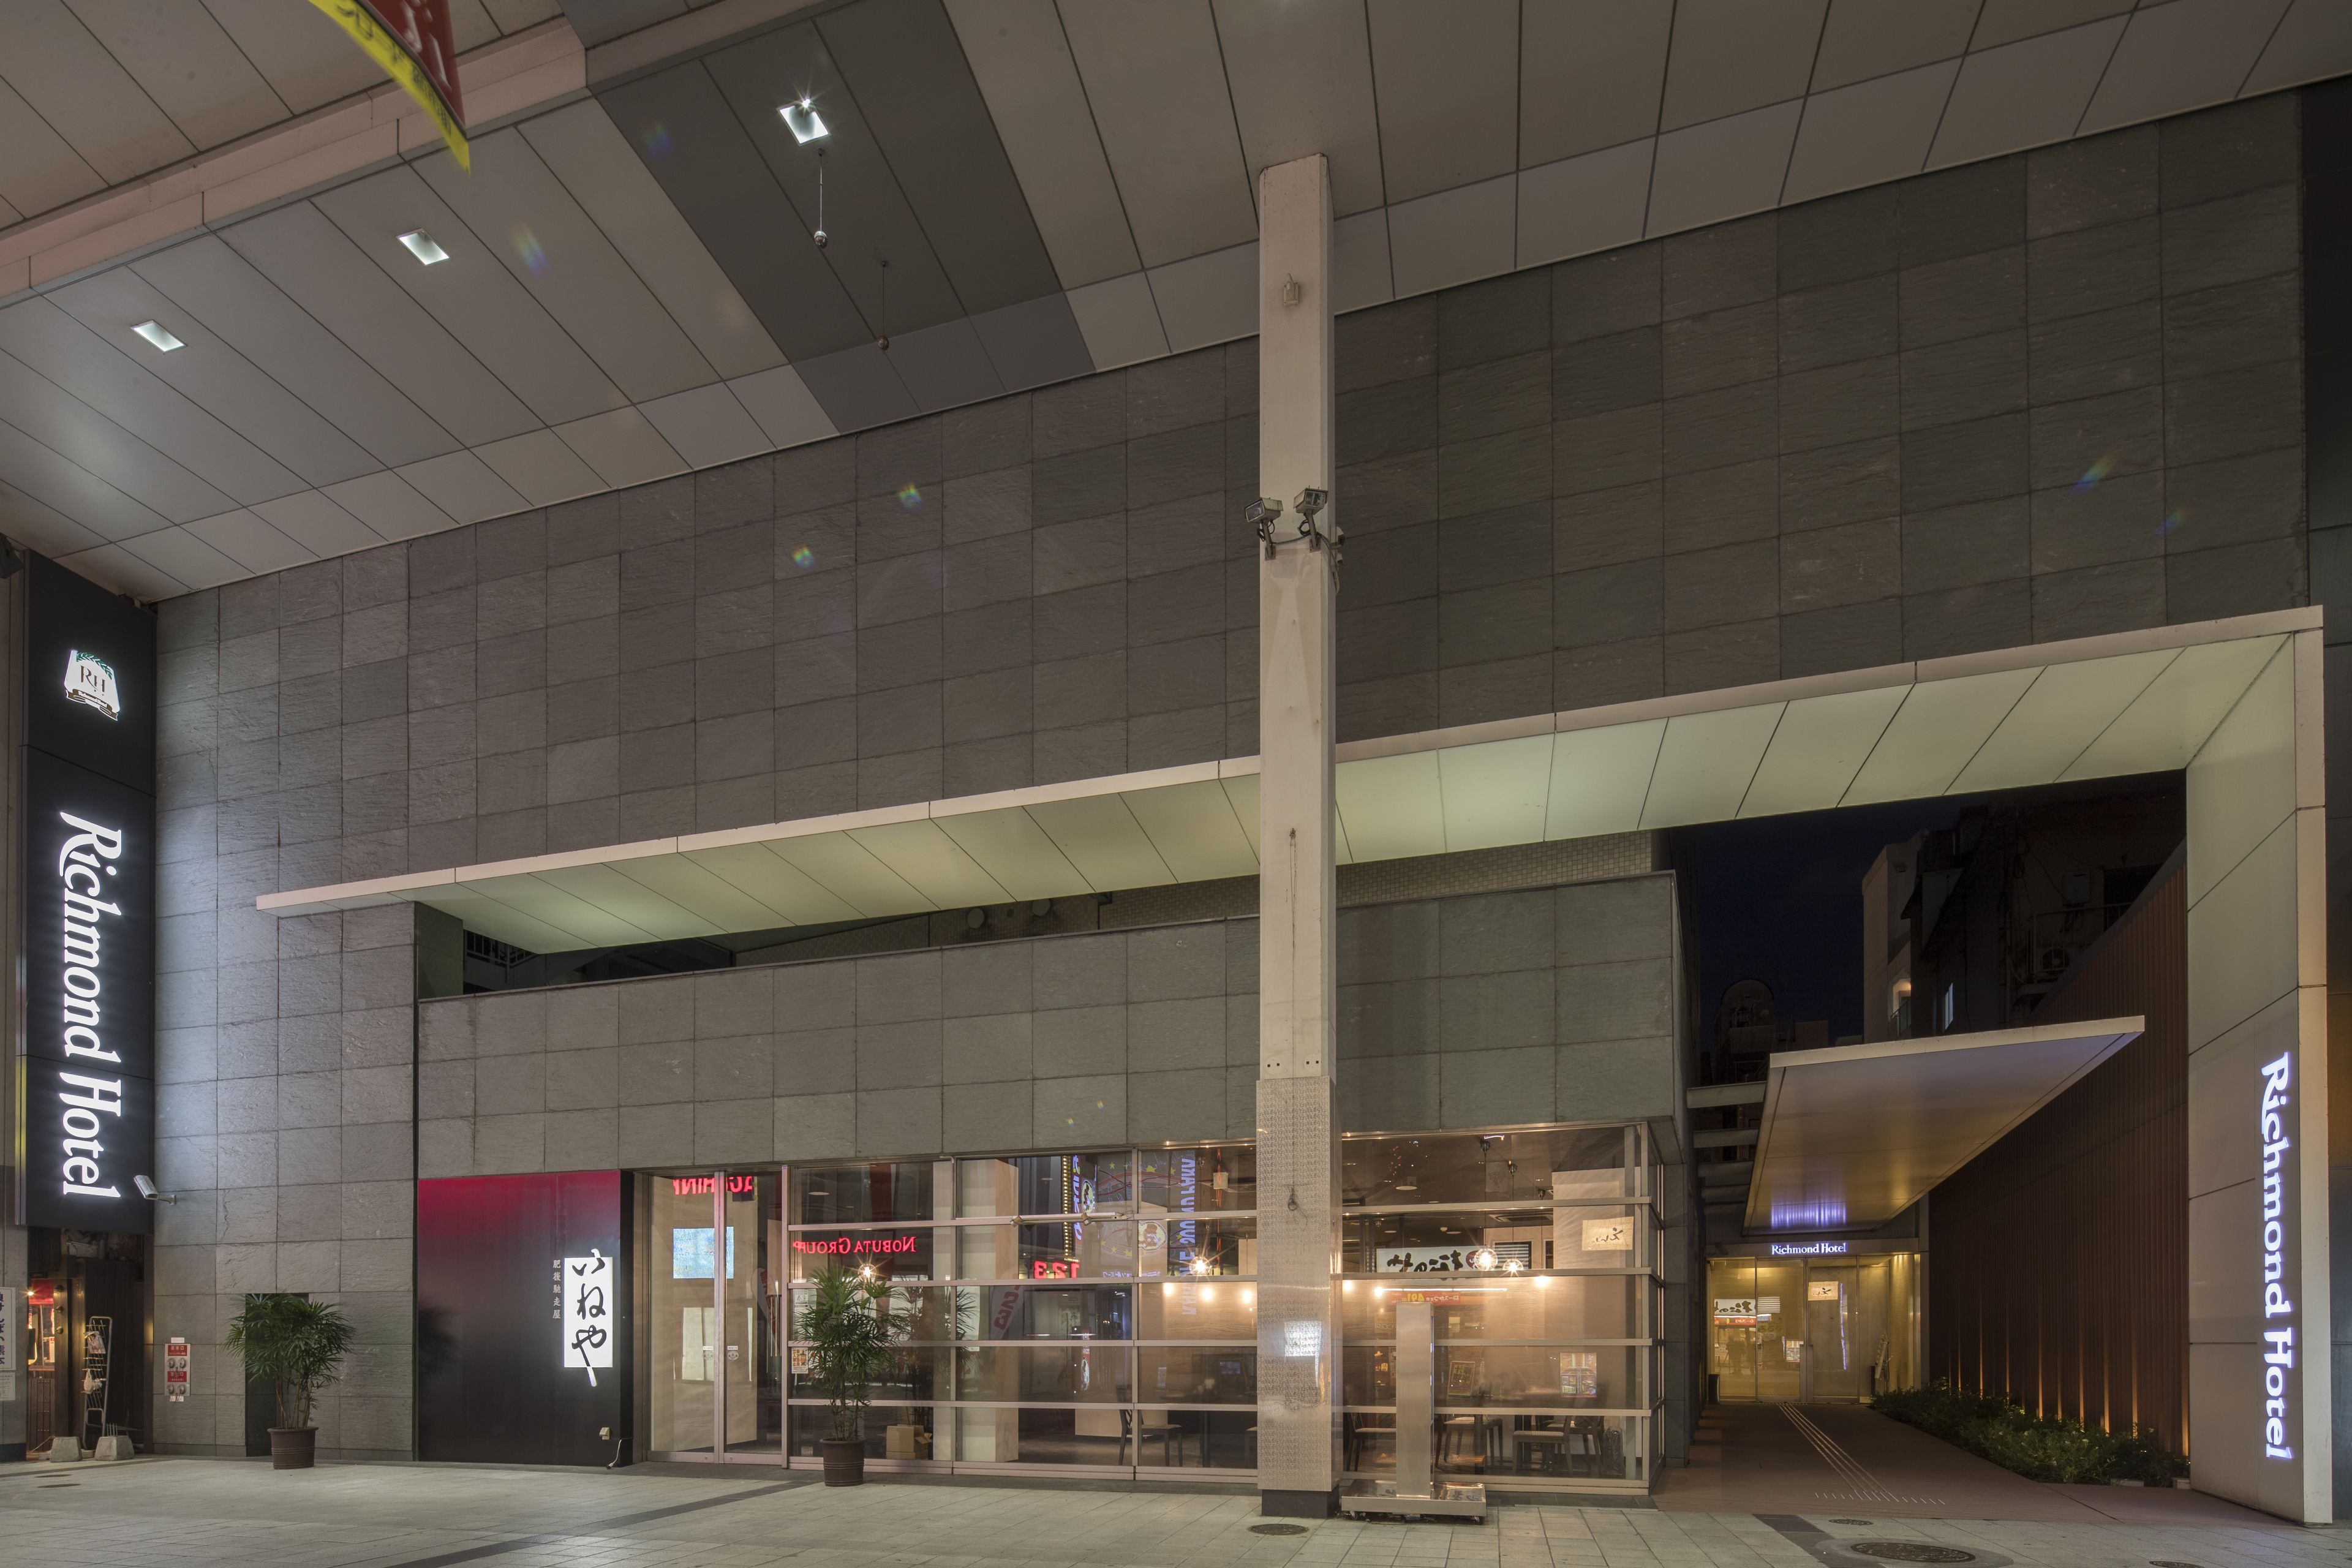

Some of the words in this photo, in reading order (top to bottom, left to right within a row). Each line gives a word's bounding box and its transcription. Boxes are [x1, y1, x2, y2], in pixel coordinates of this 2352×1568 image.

[59, 811, 123, 1064] Richmond
[59, 1072, 123, 1198] Hotel
[2260, 1051, 2294, 1318] Richmond
[552, 1259, 561, 1319] 肥後馳走屋
[1771, 1244, 1820, 1255] Richmond
[1821, 1242, 1847, 1254] Hotel
[2264, 1327, 2296, 1461] Hotel
